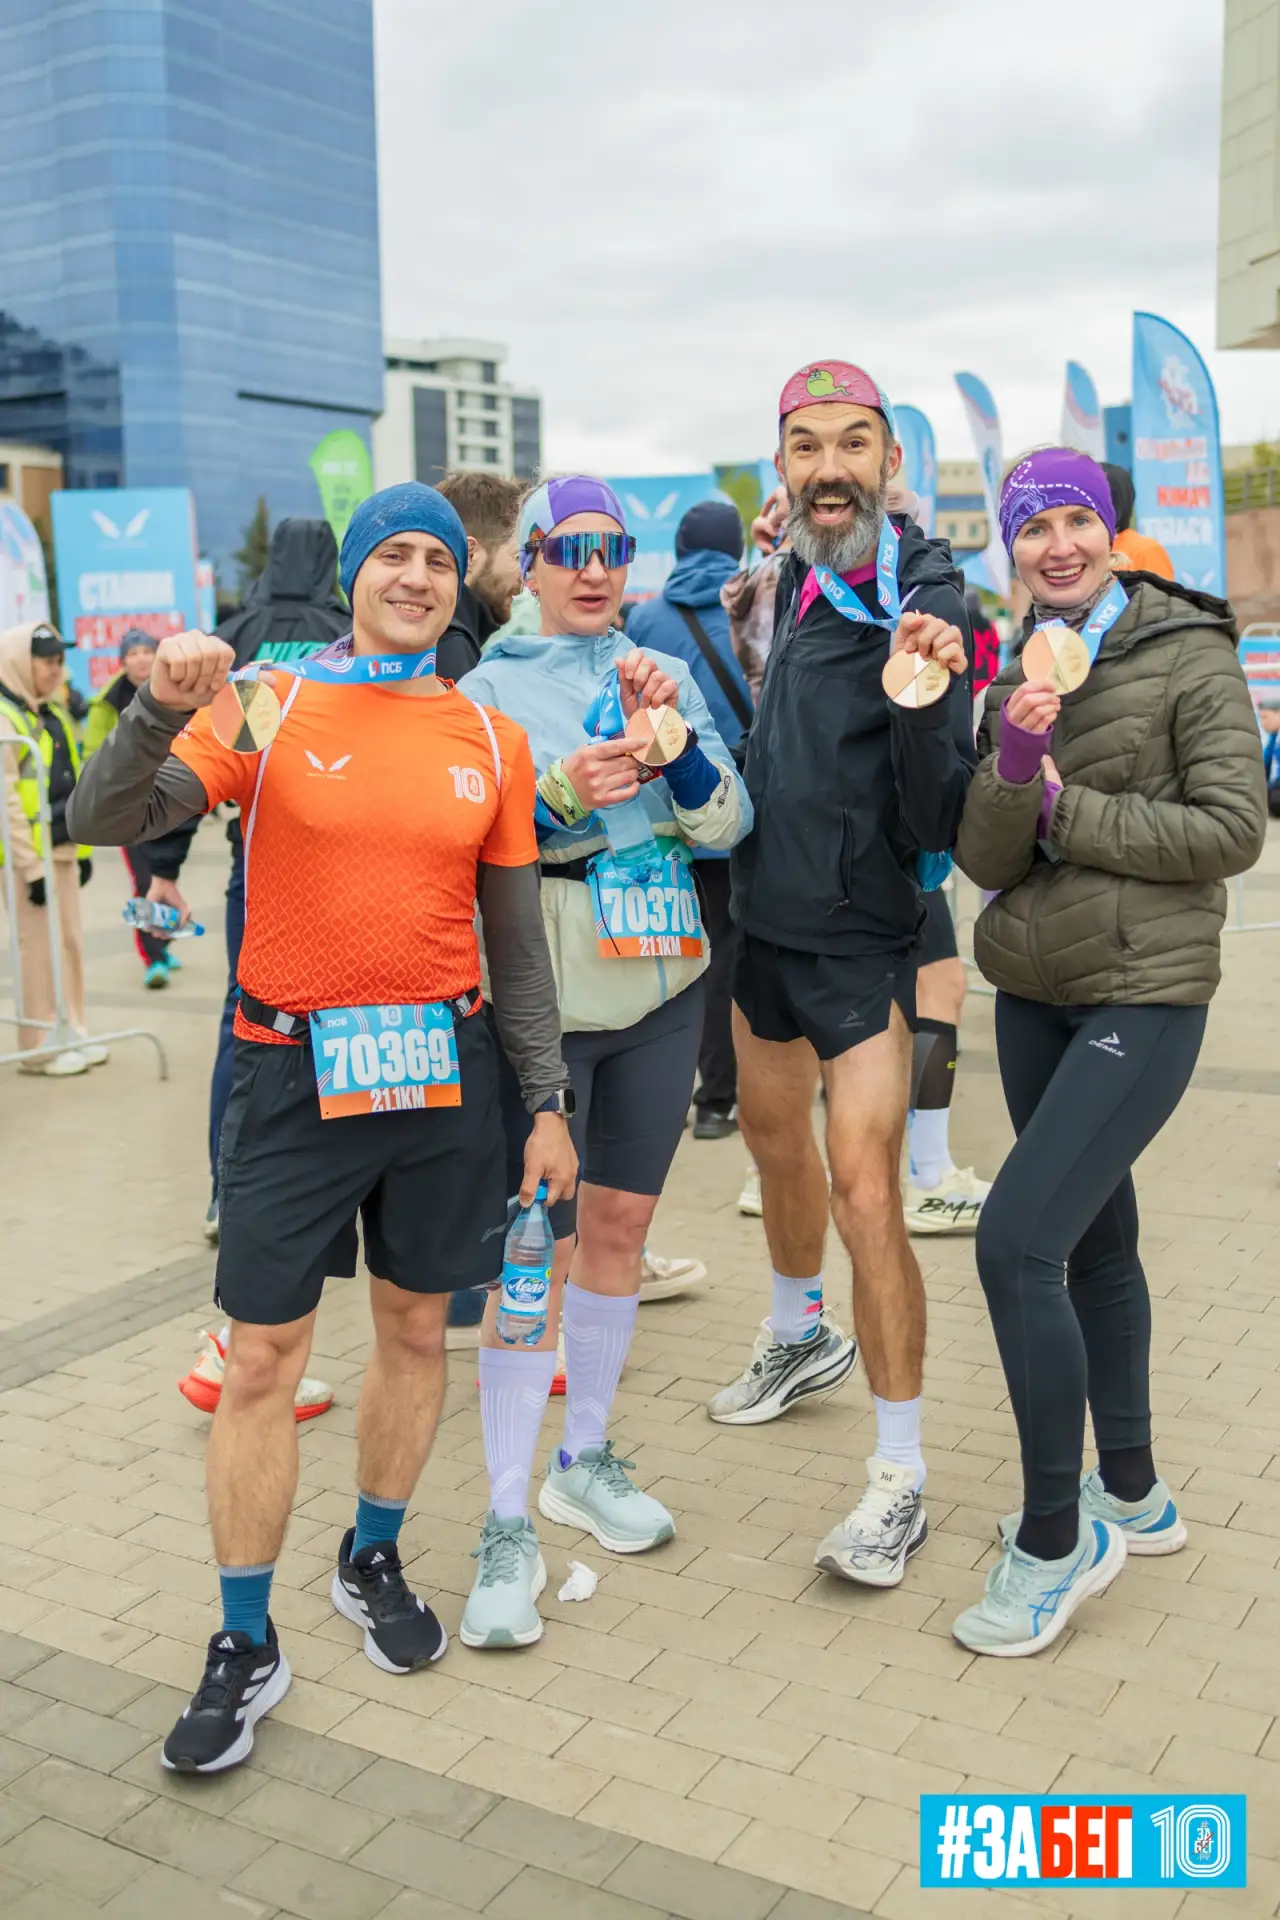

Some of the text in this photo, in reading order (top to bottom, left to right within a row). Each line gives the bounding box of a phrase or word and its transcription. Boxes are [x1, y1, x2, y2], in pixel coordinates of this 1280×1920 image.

[827, 582, 846, 601] ПСБ
[381, 661, 403, 676] ПСБ
[601, 886, 696, 934] 70370
[322, 1028, 452, 1090] 70369
